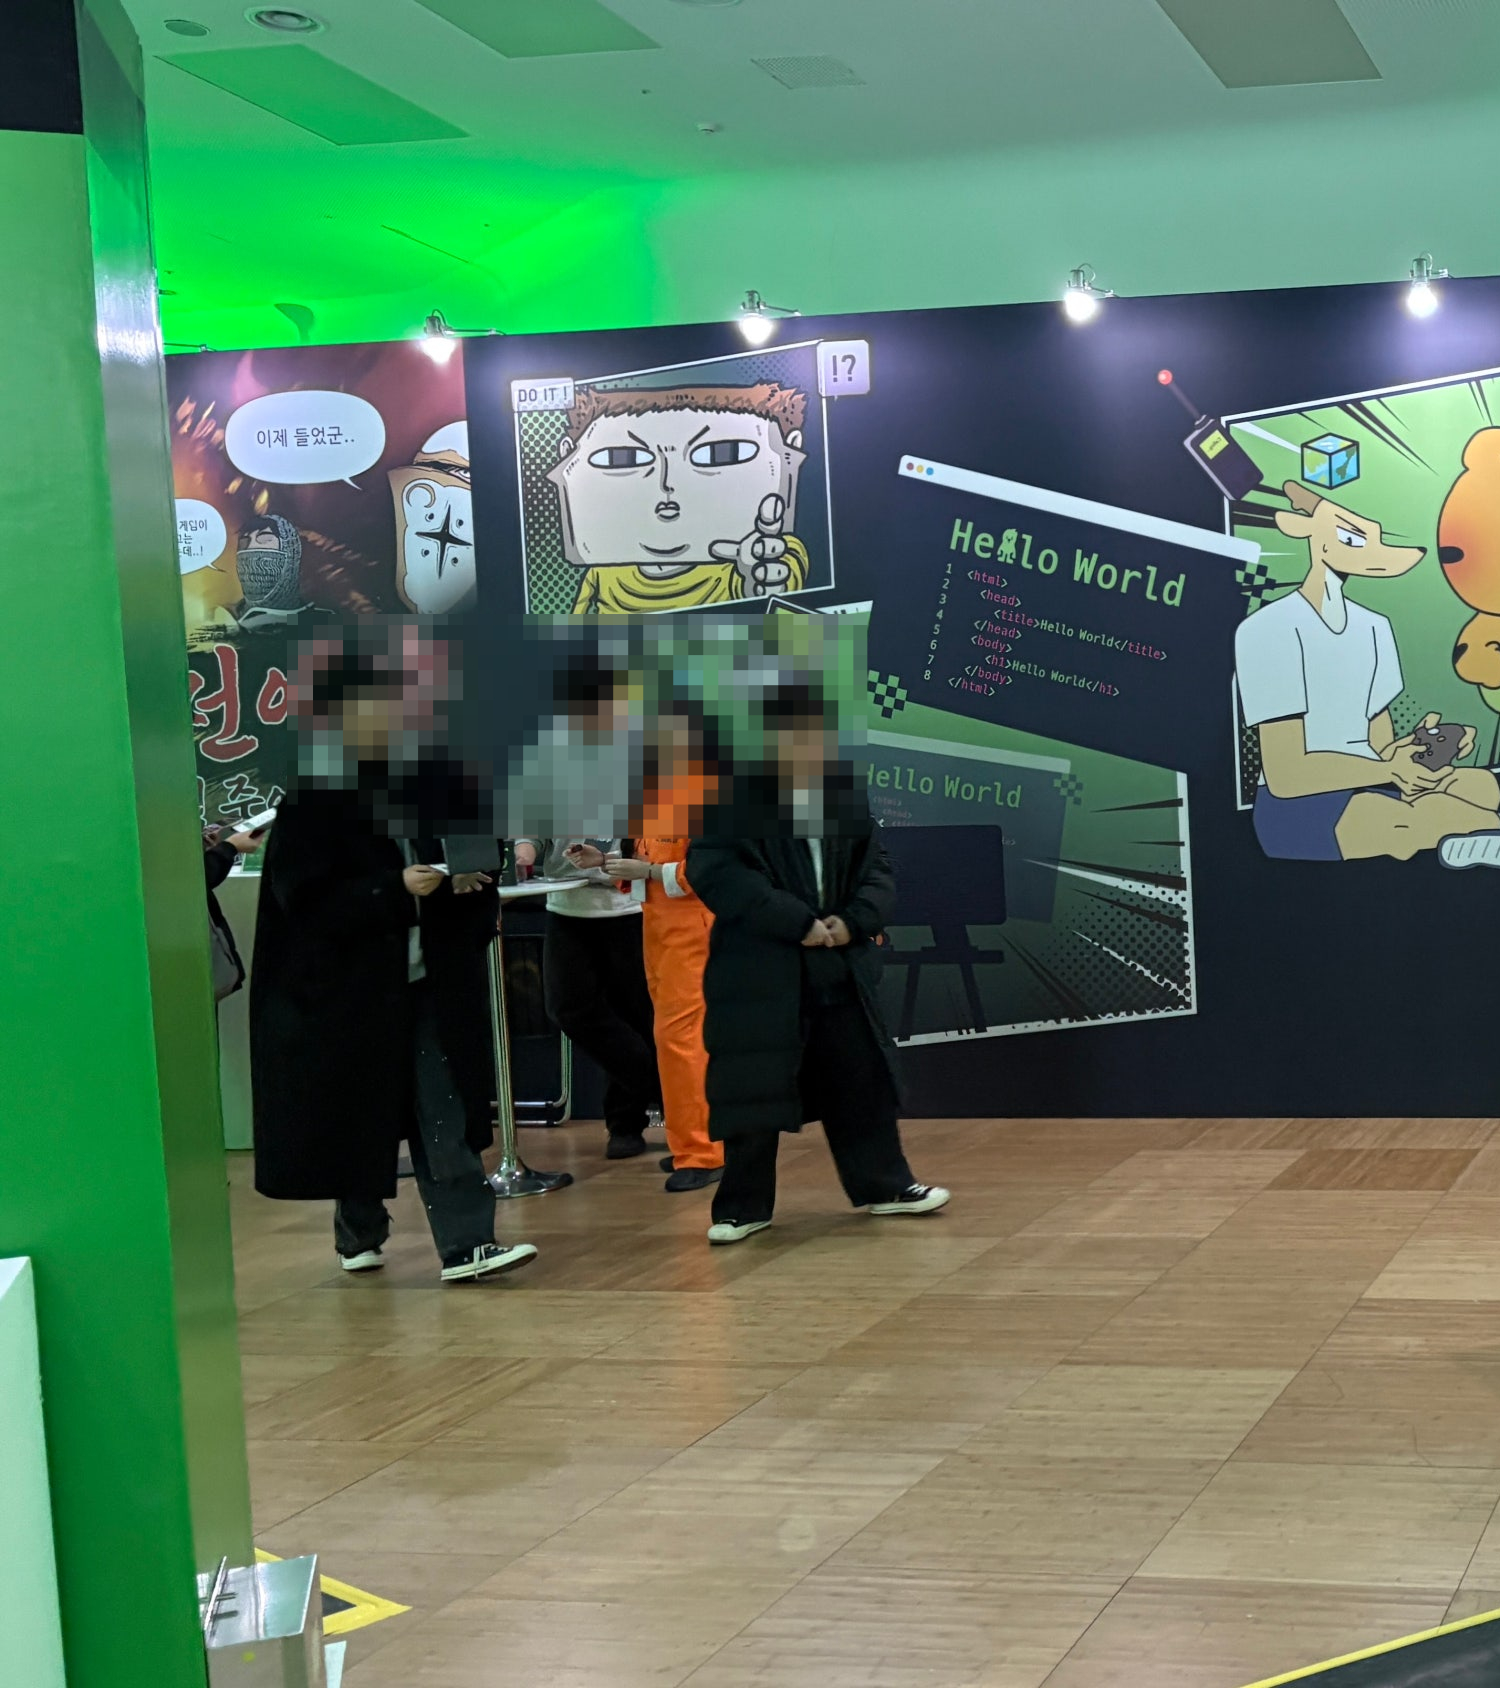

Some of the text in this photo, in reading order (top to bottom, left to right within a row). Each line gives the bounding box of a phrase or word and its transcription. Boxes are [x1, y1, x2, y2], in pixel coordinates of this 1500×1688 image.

[832, 354, 857, 384] !?
[518, 388, 540, 403] DO
[543, 387, 556, 401] IT
[257, 426, 355, 448] 이제 들었군..
[945, 563, 1008, 588] 1 <html>
[950, 518, 1186, 607] Helo World
[939, 593, 947, 605] 3
[942, 578, 1022, 607] 2 <head>
[933, 624, 1012, 653] 5 <body>
[936, 609, 1022, 640] 4 </head>
[930, 639, 937, 650] 6
[924, 669, 995, 697] 8 </html>
[927, 654, 1013, 685] 7 </body>
[943, 774, 1022, 808] World
